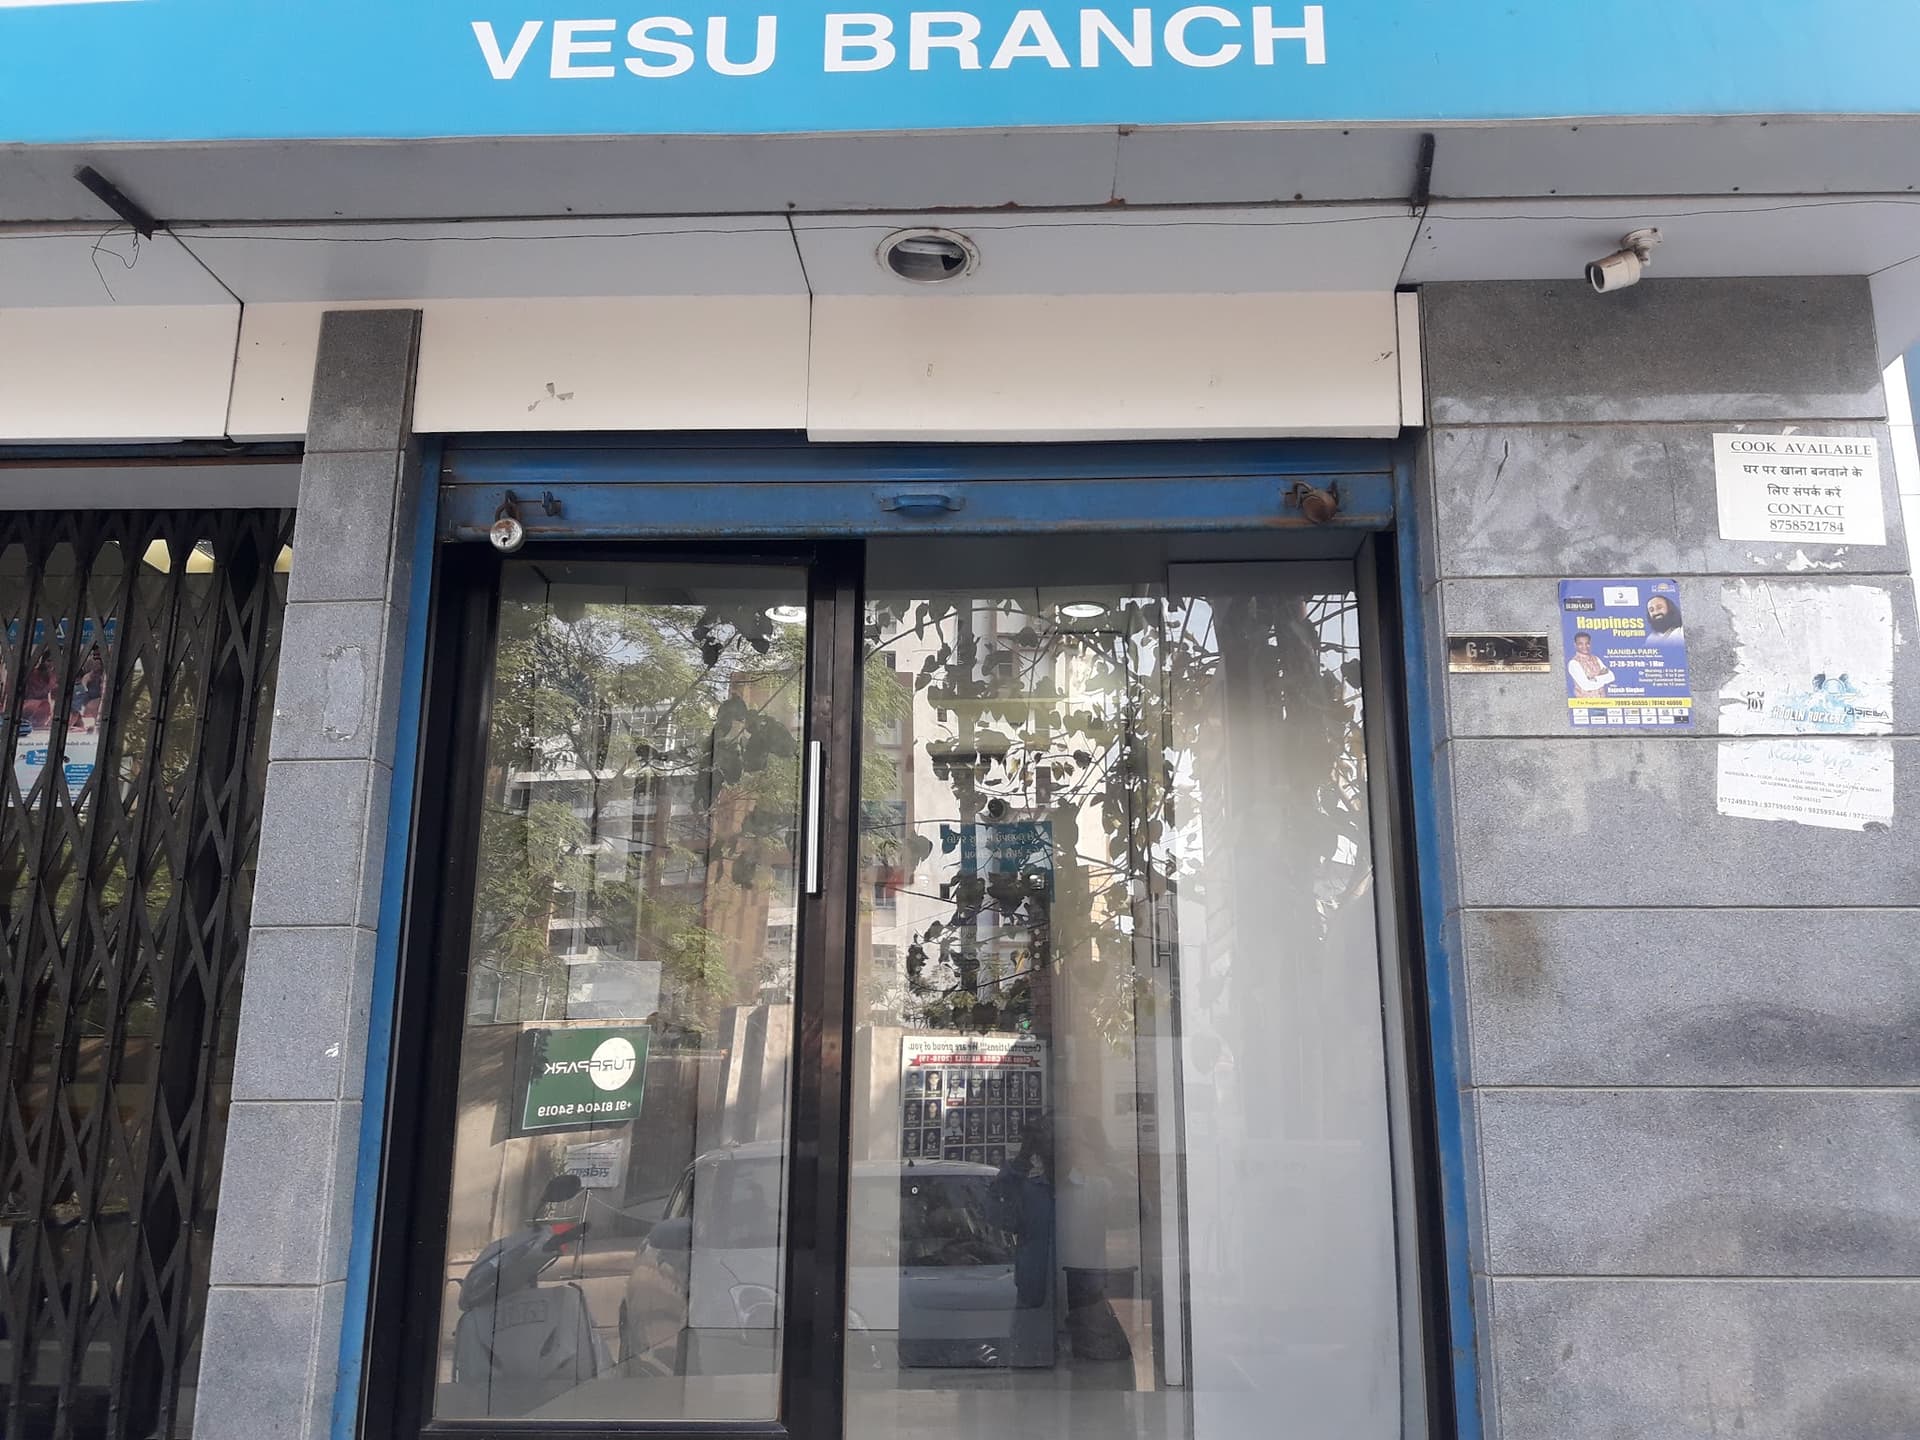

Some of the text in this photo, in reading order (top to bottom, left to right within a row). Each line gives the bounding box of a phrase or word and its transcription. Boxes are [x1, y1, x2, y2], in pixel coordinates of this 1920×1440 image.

[471, 5, 1327, 80] VESU BRANCH
[1731, 440, 1872, 456] COOK AVAILABLE
[1743, 464, 1863, 478] घर पर खाना बनवाने के
[1767, 483, 1790, 496] लिए
[1767, 503, 1844, 516] CONTACT
[1769, 519, 1844, 533] 8758521784
[1576, 615, 1645, 630] Happiness
[1612, 629, 1646, 638] Program
[1638, 648, 1659, 656] PARK
[1747, 699, 1764, 710] JOY
